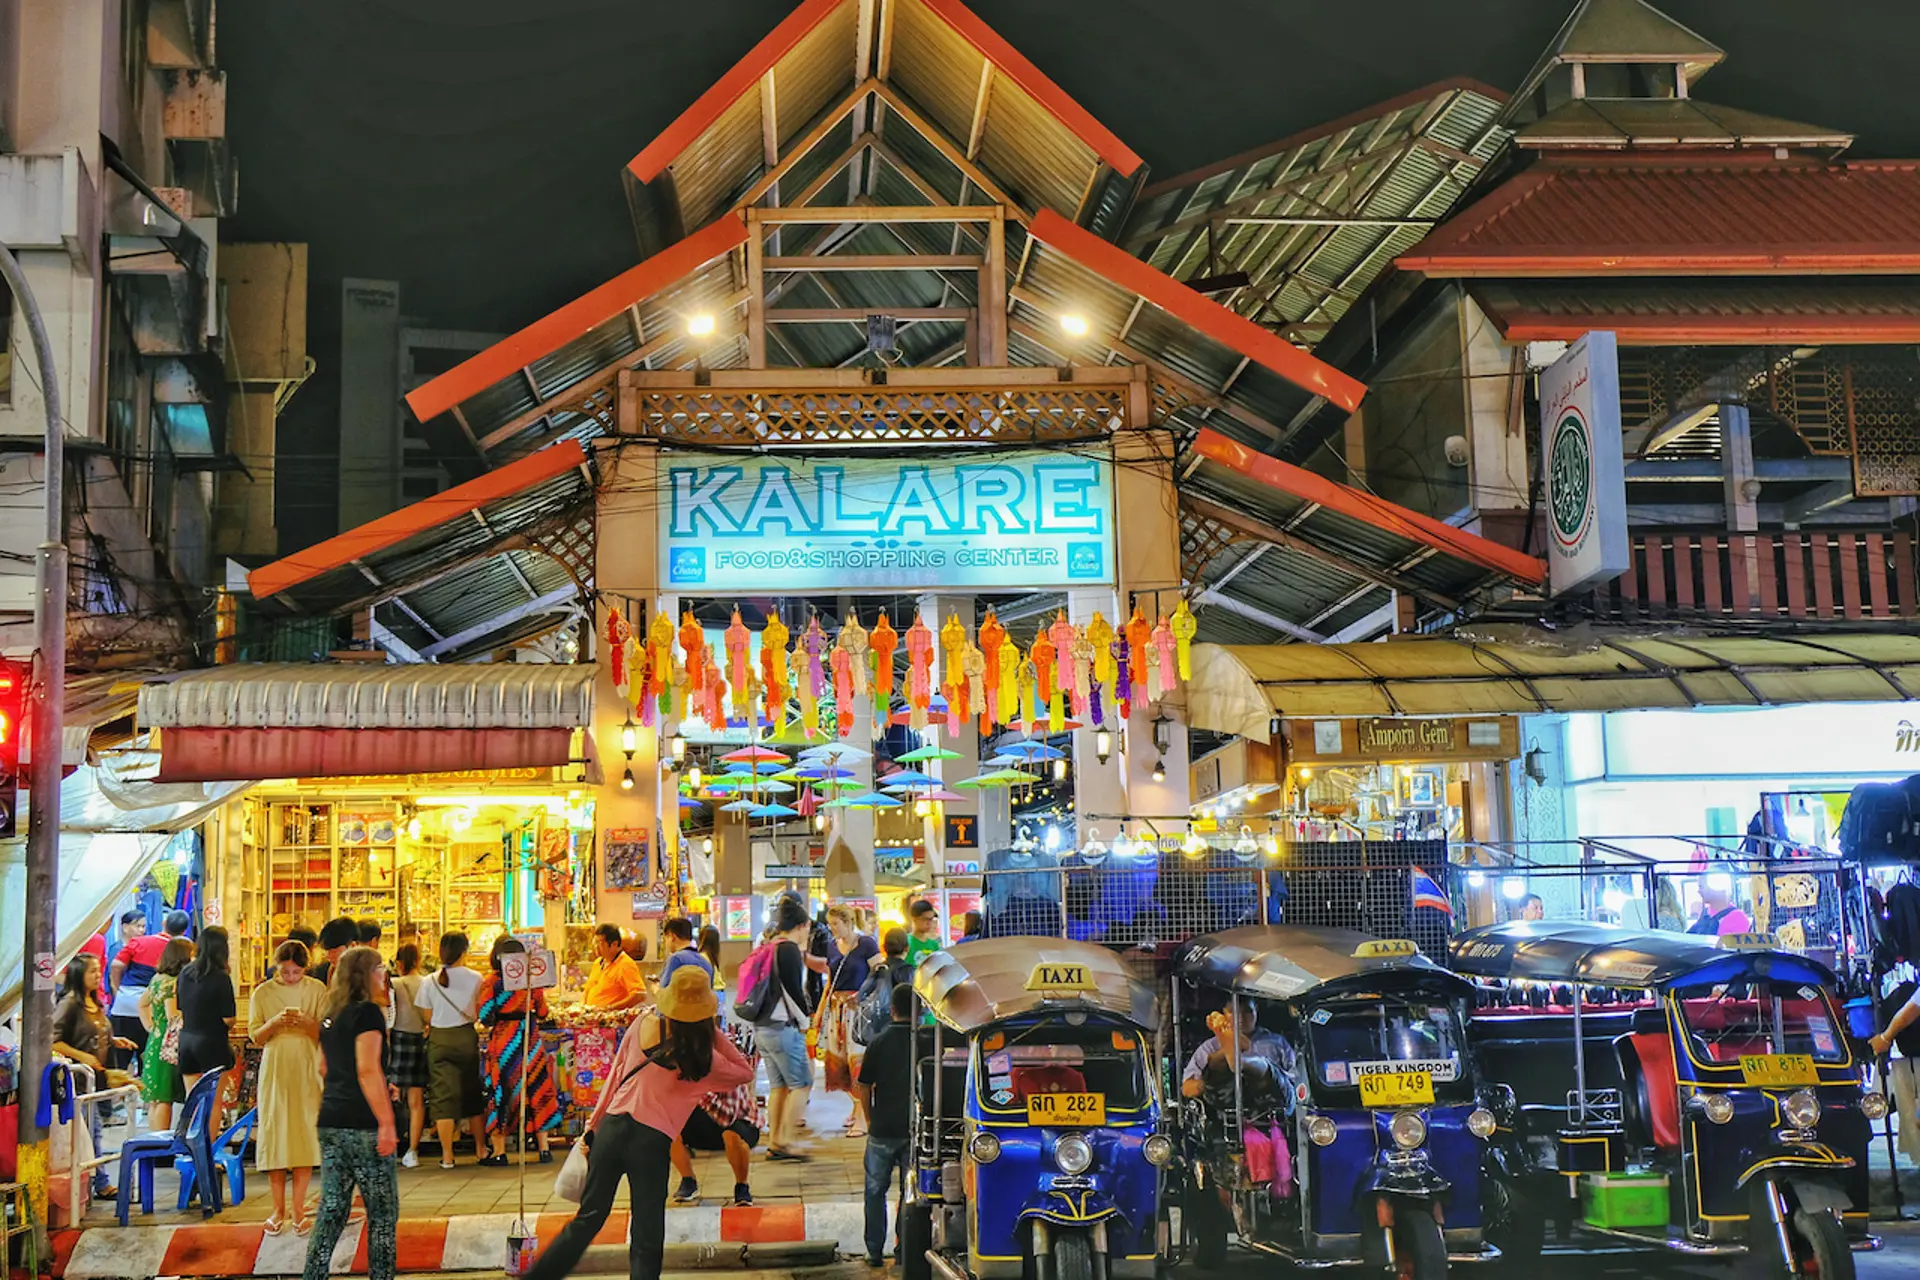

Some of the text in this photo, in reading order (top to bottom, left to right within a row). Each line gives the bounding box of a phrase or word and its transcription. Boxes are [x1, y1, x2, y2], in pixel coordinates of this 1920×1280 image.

[669, 461, 1102, 538] KALARE
[715, 548, 1058, 569] FOOD&SHOPPING CENTER
[672, 564, 703, 577] Chang
[1367, 721, 1449, 751] Amporn Gem
[1371, 942, 1410, 952] TAXI
[1732, 934, 1774, 945] TAXI
[1039, 967, 1084, 984] TAXI
[1354, 1064, 1391, 1075] TIGER
[1396, 1063, 1452, 1073] KINGDOM
[1779, 1057, 1807, 1072] 875
[1396, 1074, 1425, 1091] 749
[1067, 1095, 1097, 1111] 282
